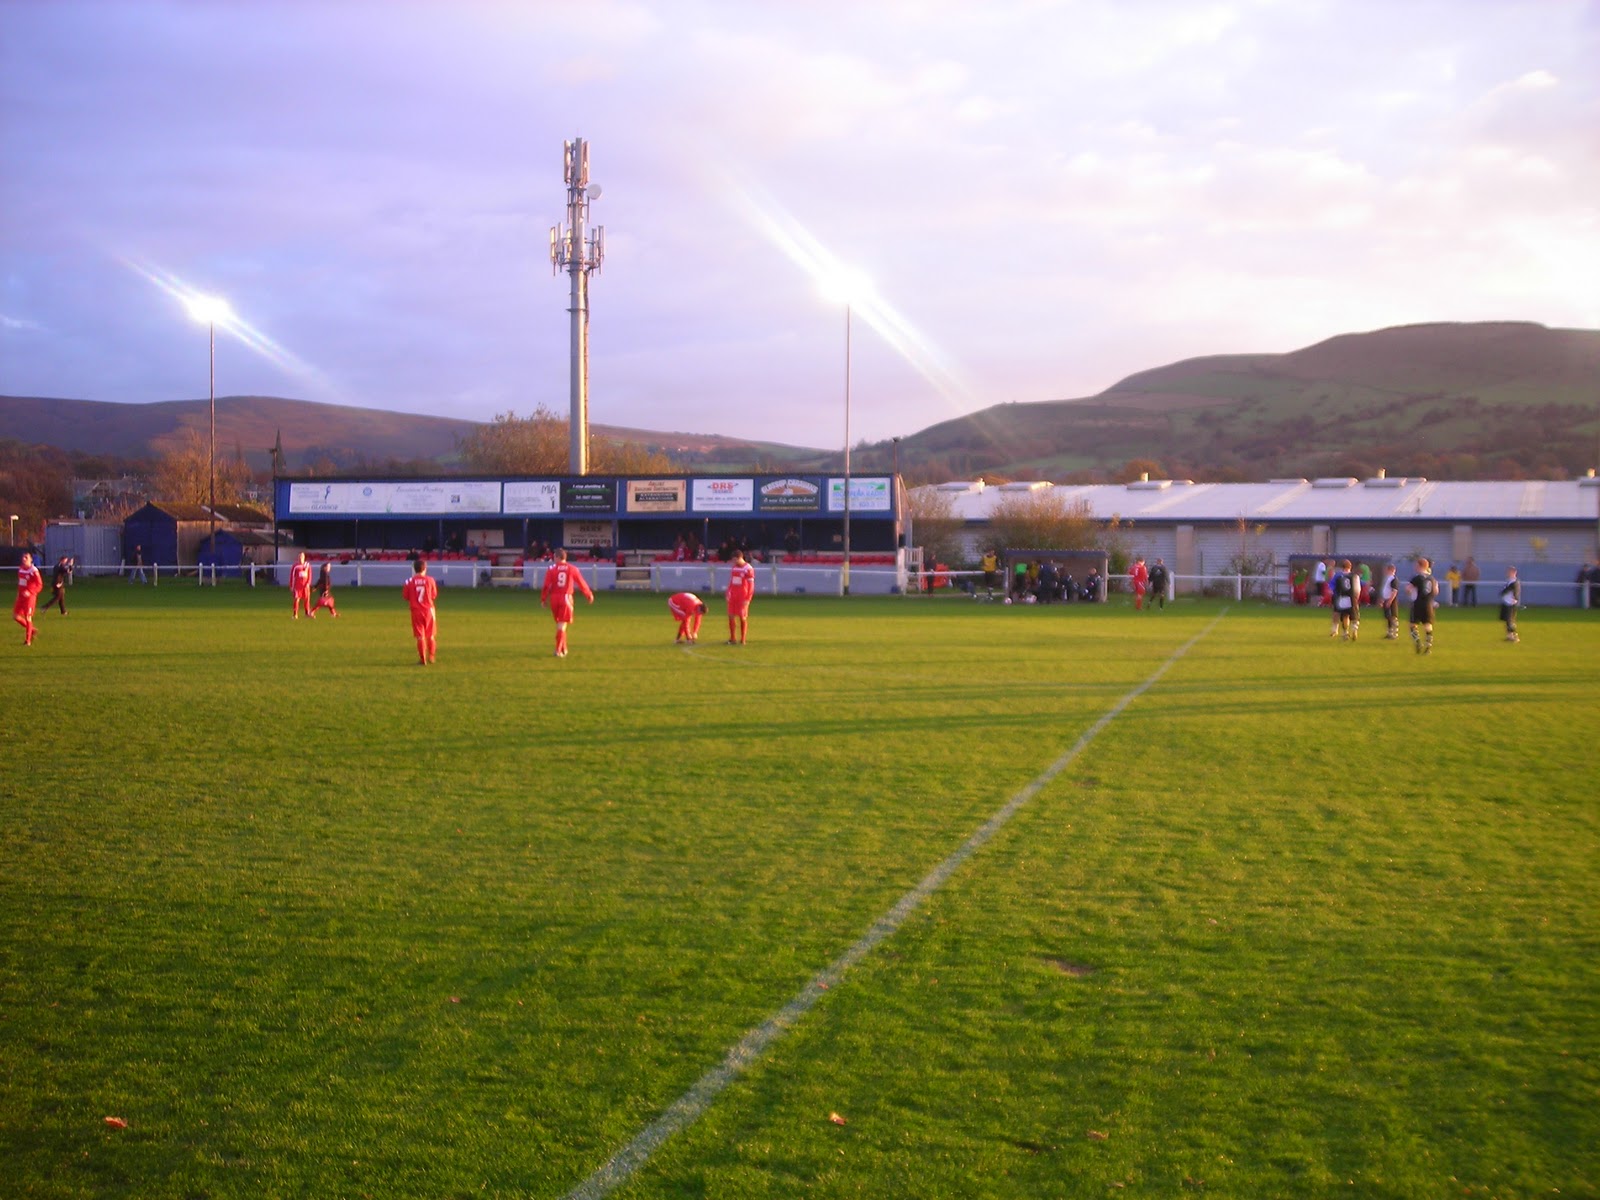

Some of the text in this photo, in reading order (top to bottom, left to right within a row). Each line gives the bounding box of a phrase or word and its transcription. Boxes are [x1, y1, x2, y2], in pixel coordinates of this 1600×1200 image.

[557, 572, 567, 587] 9
[1344, 578, 1351, 590] 8
[416, 586, 425, 603] 7
